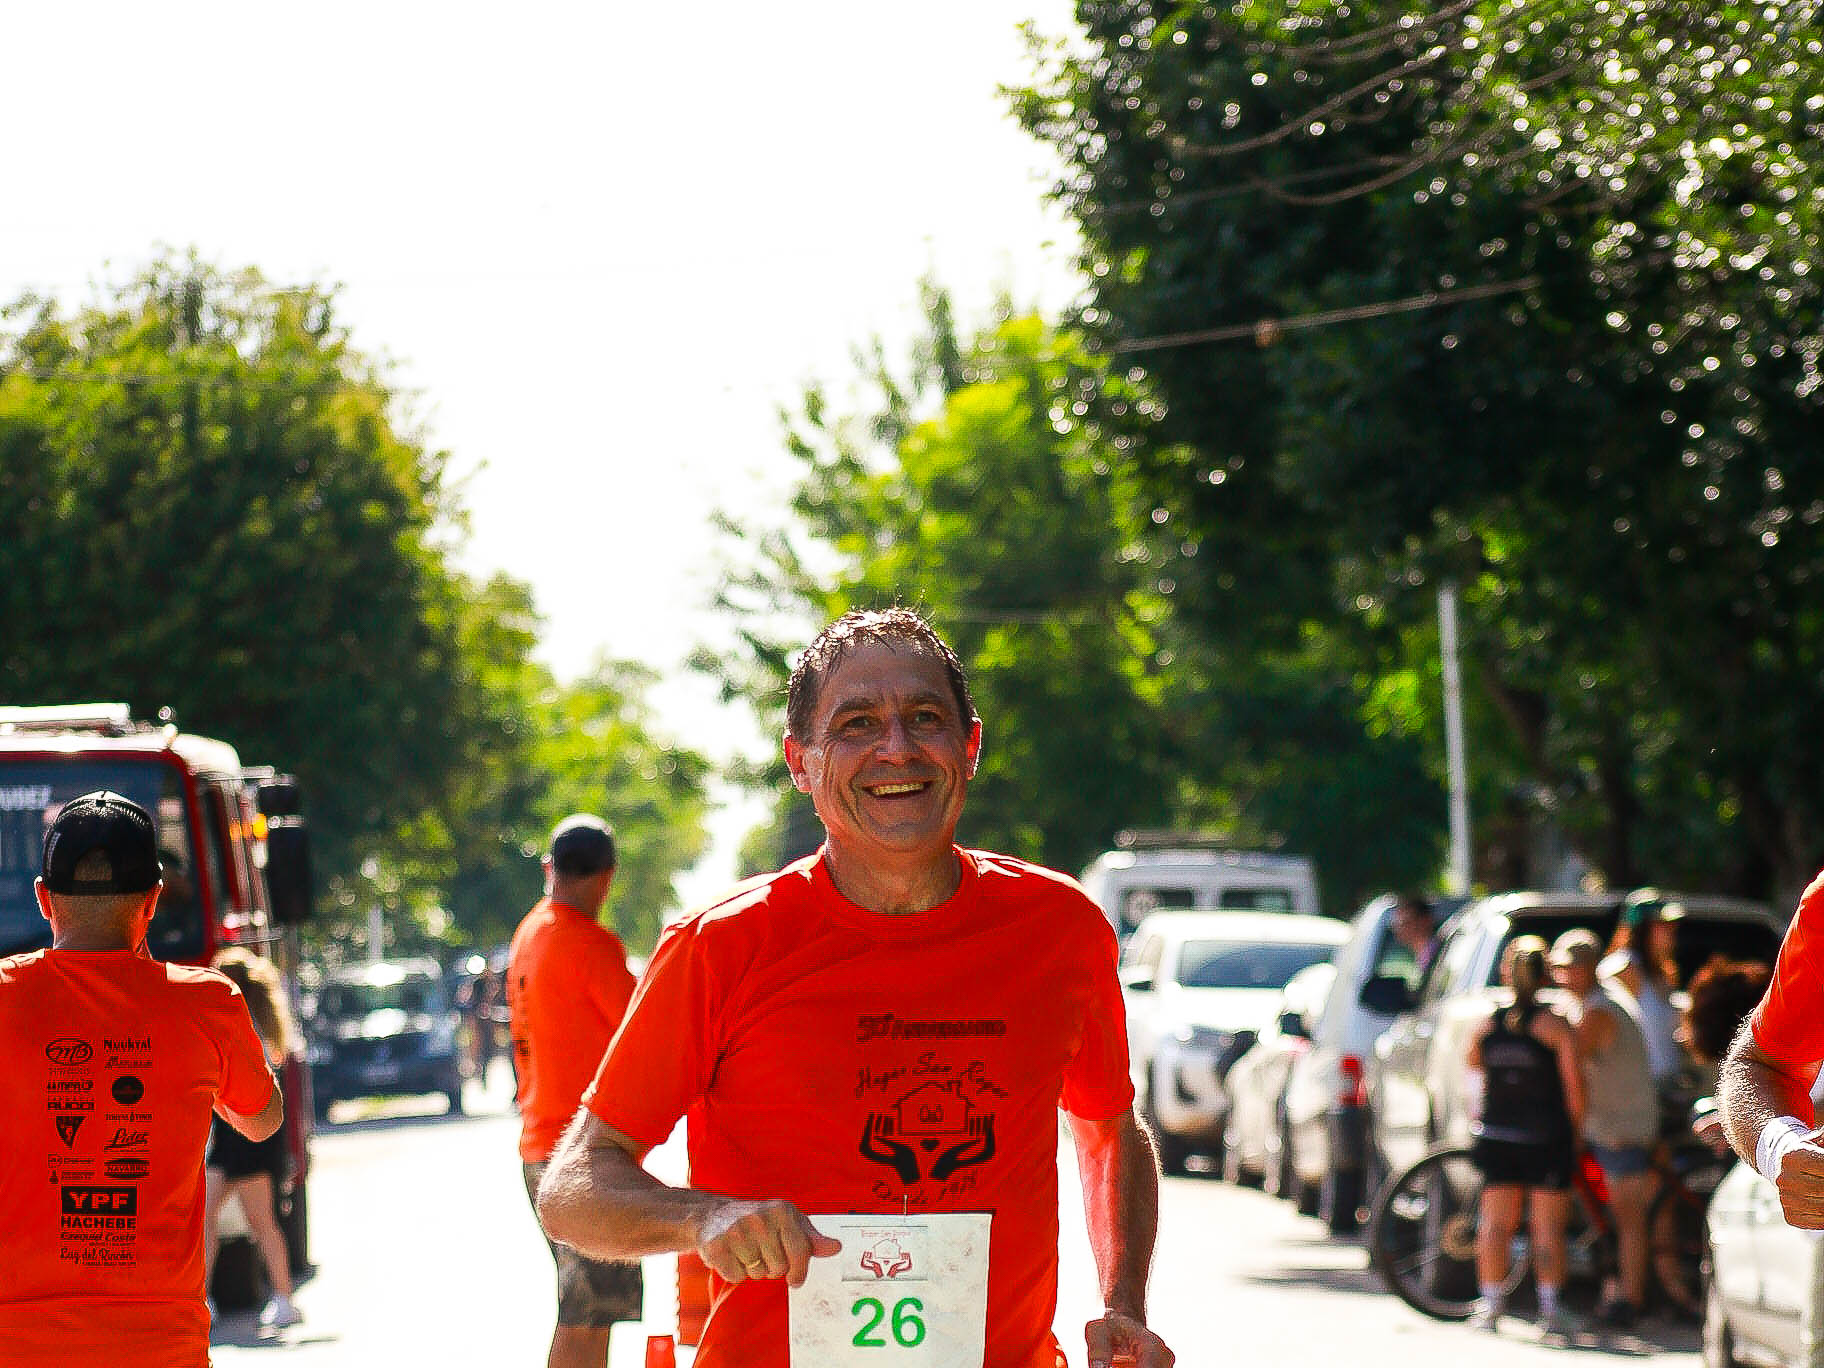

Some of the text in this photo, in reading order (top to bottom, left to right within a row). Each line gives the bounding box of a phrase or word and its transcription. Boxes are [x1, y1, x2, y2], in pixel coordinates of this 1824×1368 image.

[69, 1191, 129, 1209] YPF
[61, 1216, 136, 1229] HACHEBE
[851, 1297, 926, 1348] 26
